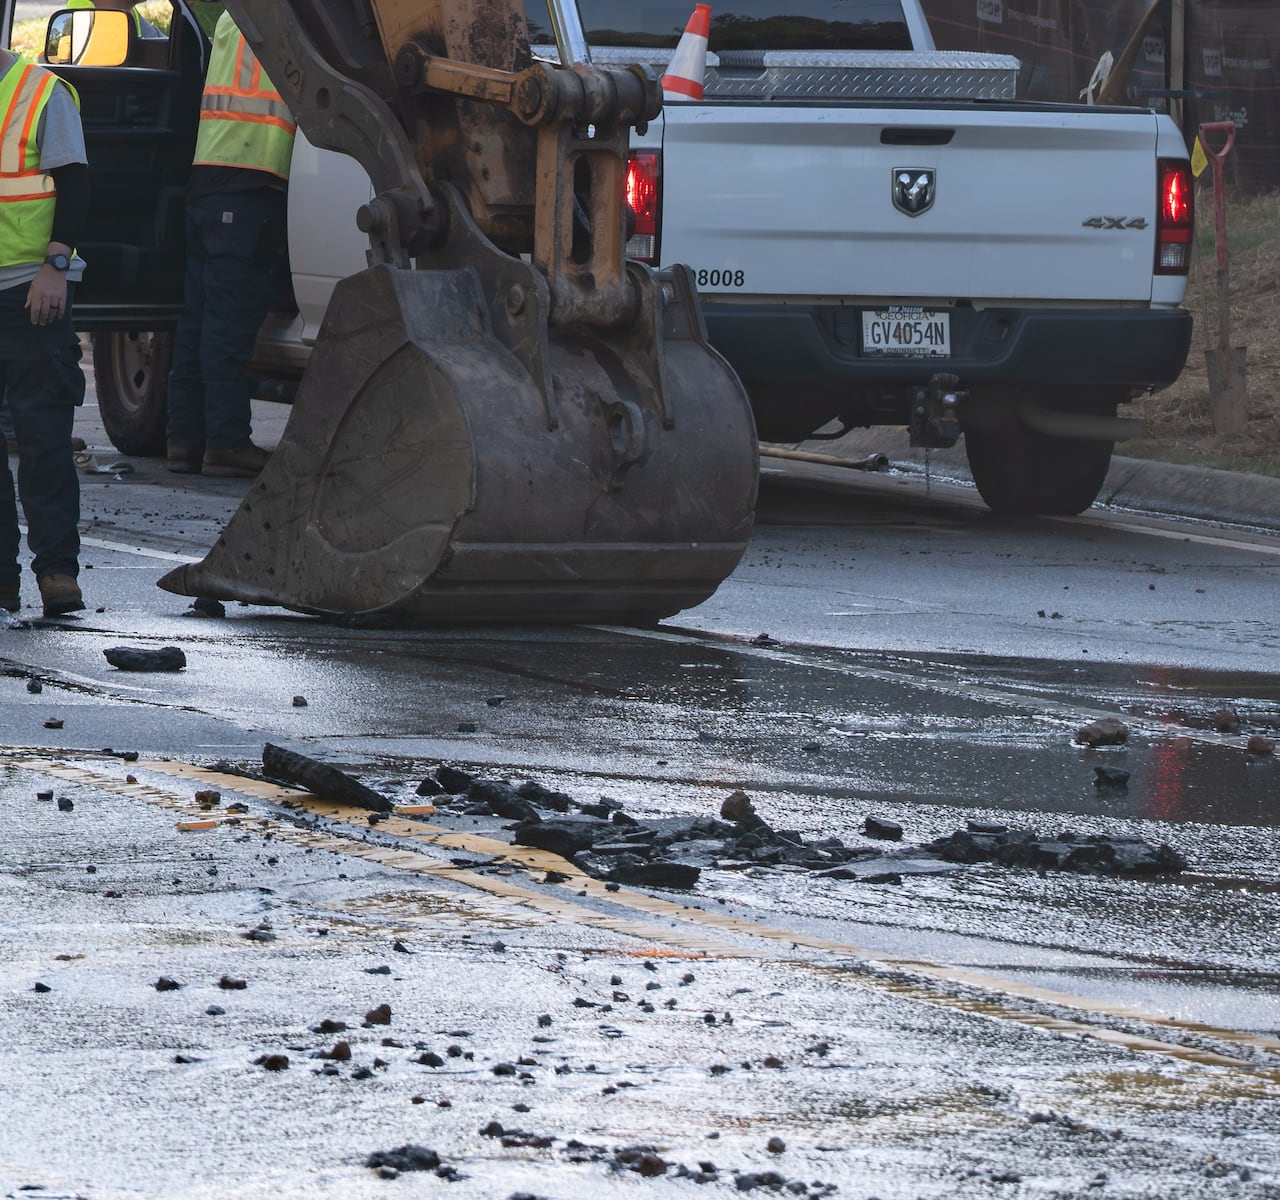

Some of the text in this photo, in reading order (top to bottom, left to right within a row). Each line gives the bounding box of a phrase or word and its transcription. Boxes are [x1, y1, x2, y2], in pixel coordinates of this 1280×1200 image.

[1082, 216, 1148, 230] 4X4
[879, 312, 930, 321] GEORGIA
[871, 322, 945, 346] GV4054N
